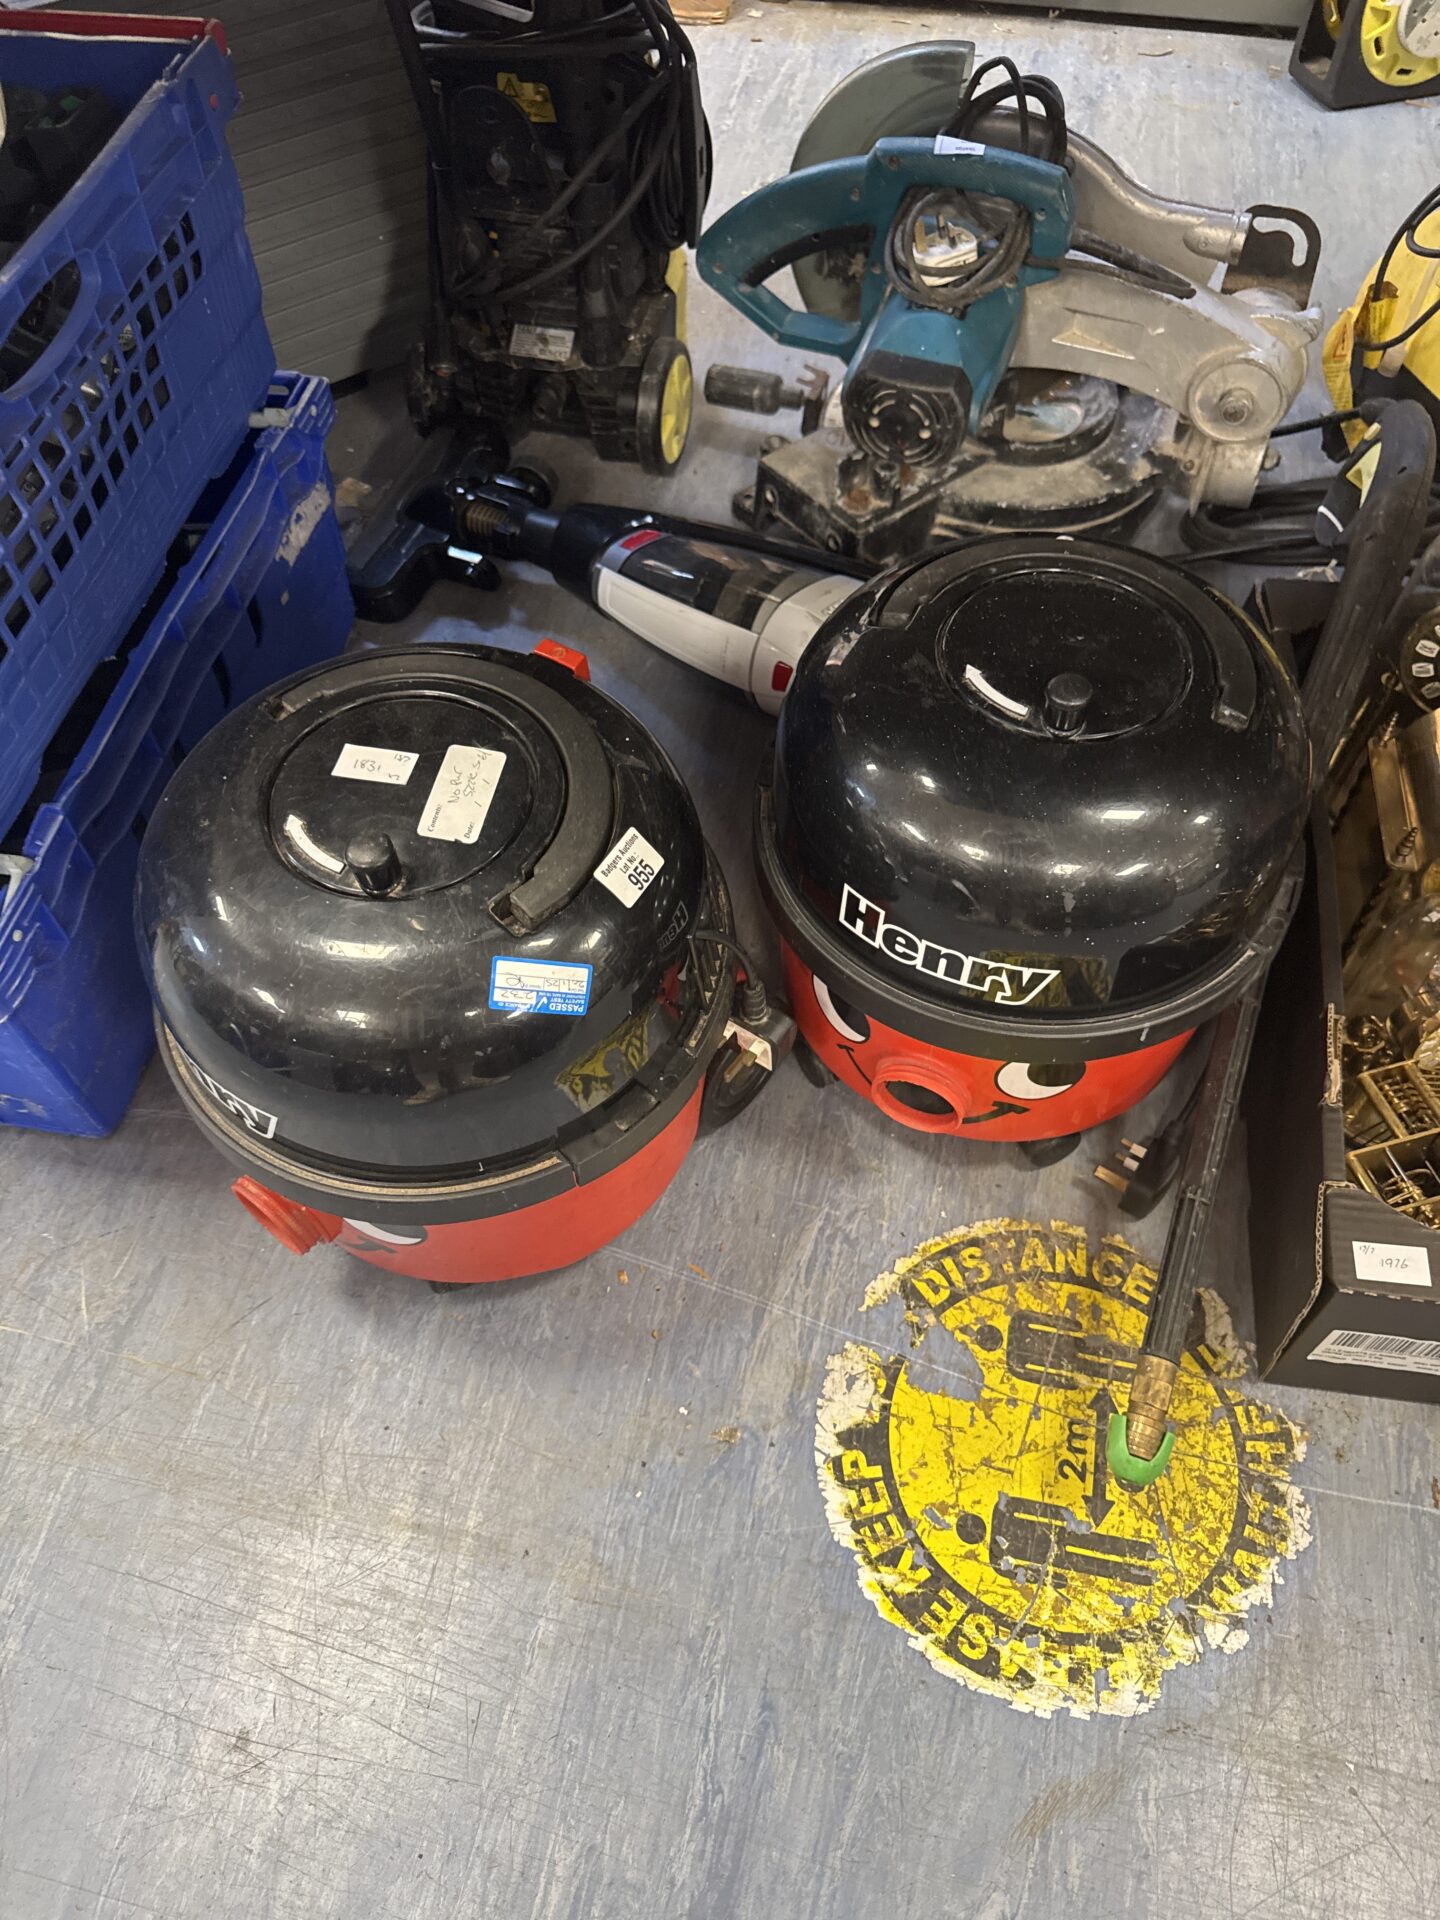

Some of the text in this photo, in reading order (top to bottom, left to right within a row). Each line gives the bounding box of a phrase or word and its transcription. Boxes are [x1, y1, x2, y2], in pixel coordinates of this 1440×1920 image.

[427, 803, 442, 832] Contents:
[464, 822, 475, 839] Date:
[601, 834, 639, 877] Badgers Auctions
[619, 861, 632, 874] Lot
[627, 858, 655, 891] 955
[838, 882, 1062, 1006] Henry
[549, 1003, 585, 1013] PASSED
[1380, 1258, 1409, 1269] 1976
[840, 1450, 931, 1597] KEEP
[911, 1236, 1159, 1306] DISTANCE
[1058, 1418, 1089, 1484] 2m
